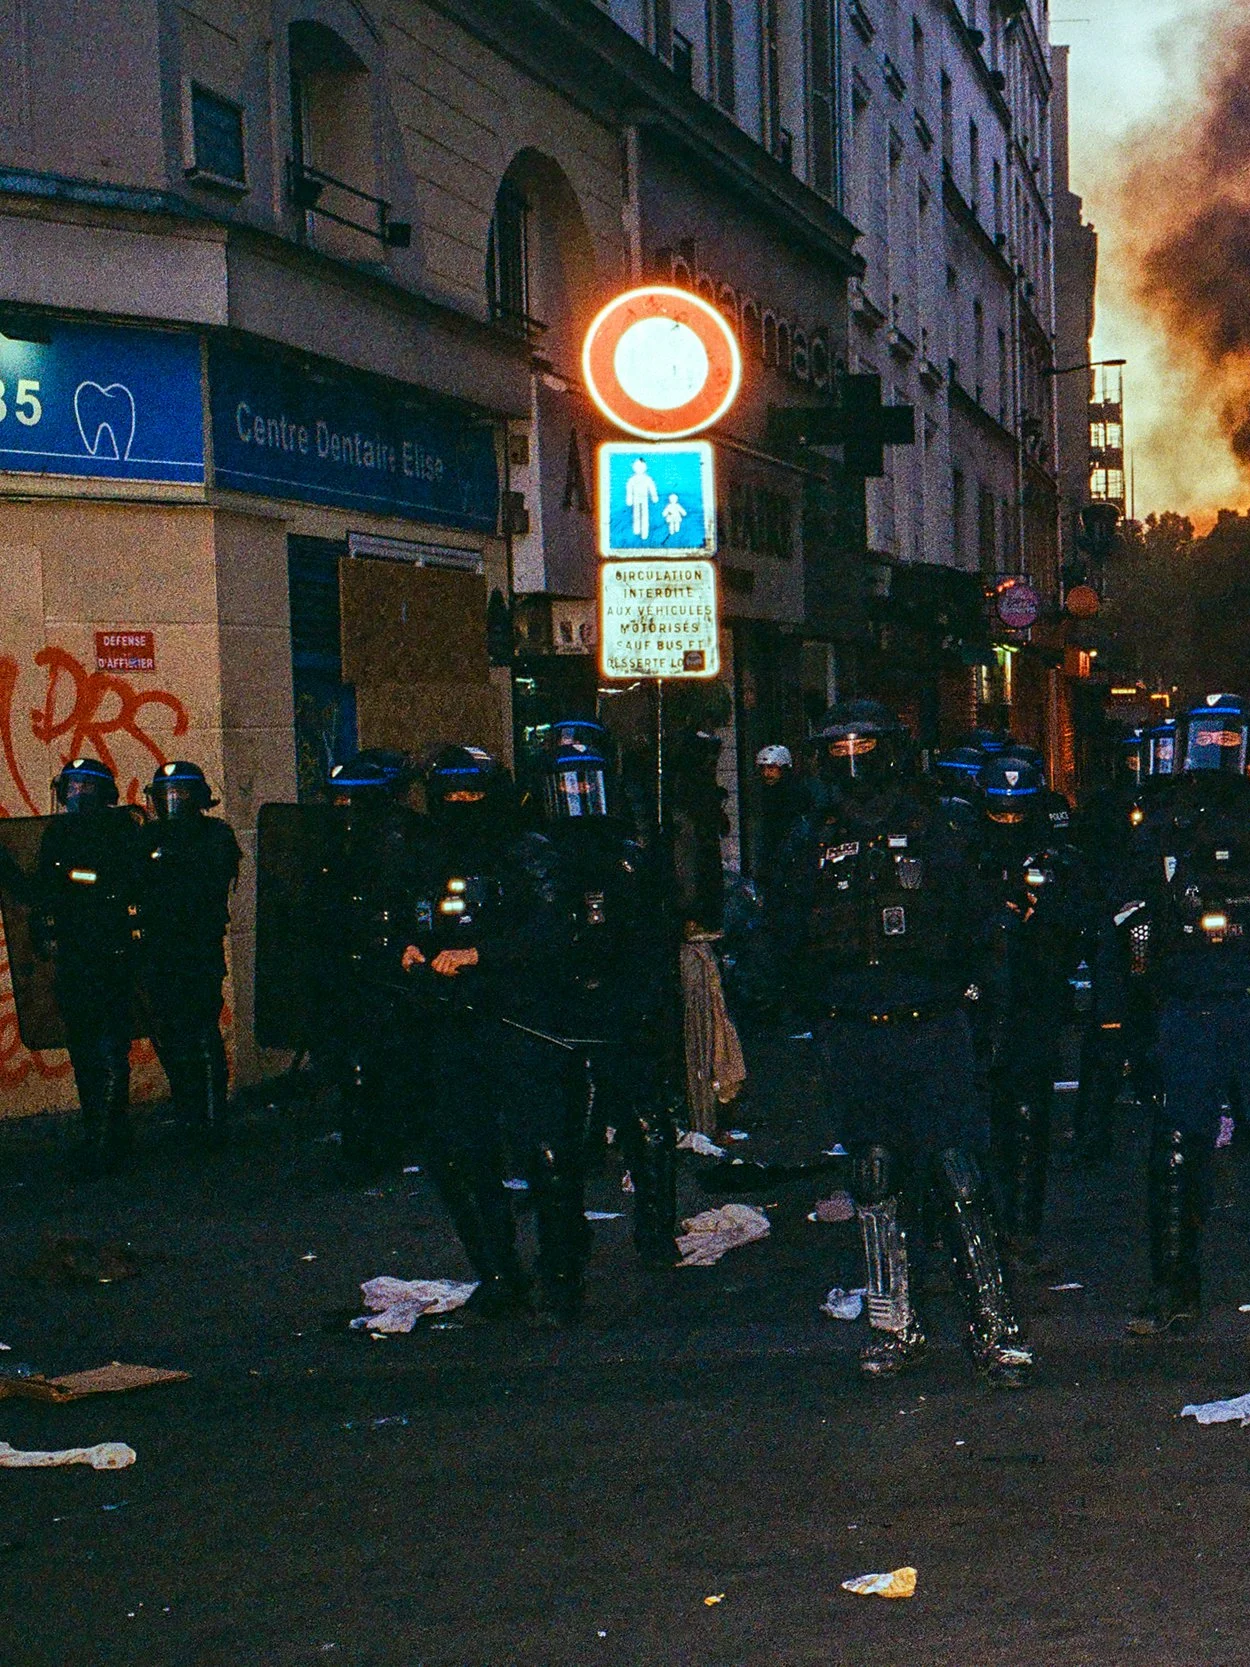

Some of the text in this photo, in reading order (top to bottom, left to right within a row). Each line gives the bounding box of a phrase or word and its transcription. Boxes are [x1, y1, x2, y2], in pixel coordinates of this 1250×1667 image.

[0, 379, 42, 426] 5
[234, 400, 444, 482] Centre Dentaire Elise
[615, 570, 703, 581] CIRCULATION
[623, 587, 694, 599] INTERDITE
[607, 606, 632, 616] AUX
[103, 635, 147, 647] DEFENSE
[616, 640, 650, 651] SAUF
[656, 640, 684, 651] BUS
[607, 657, 667, 669] DESSERTE
